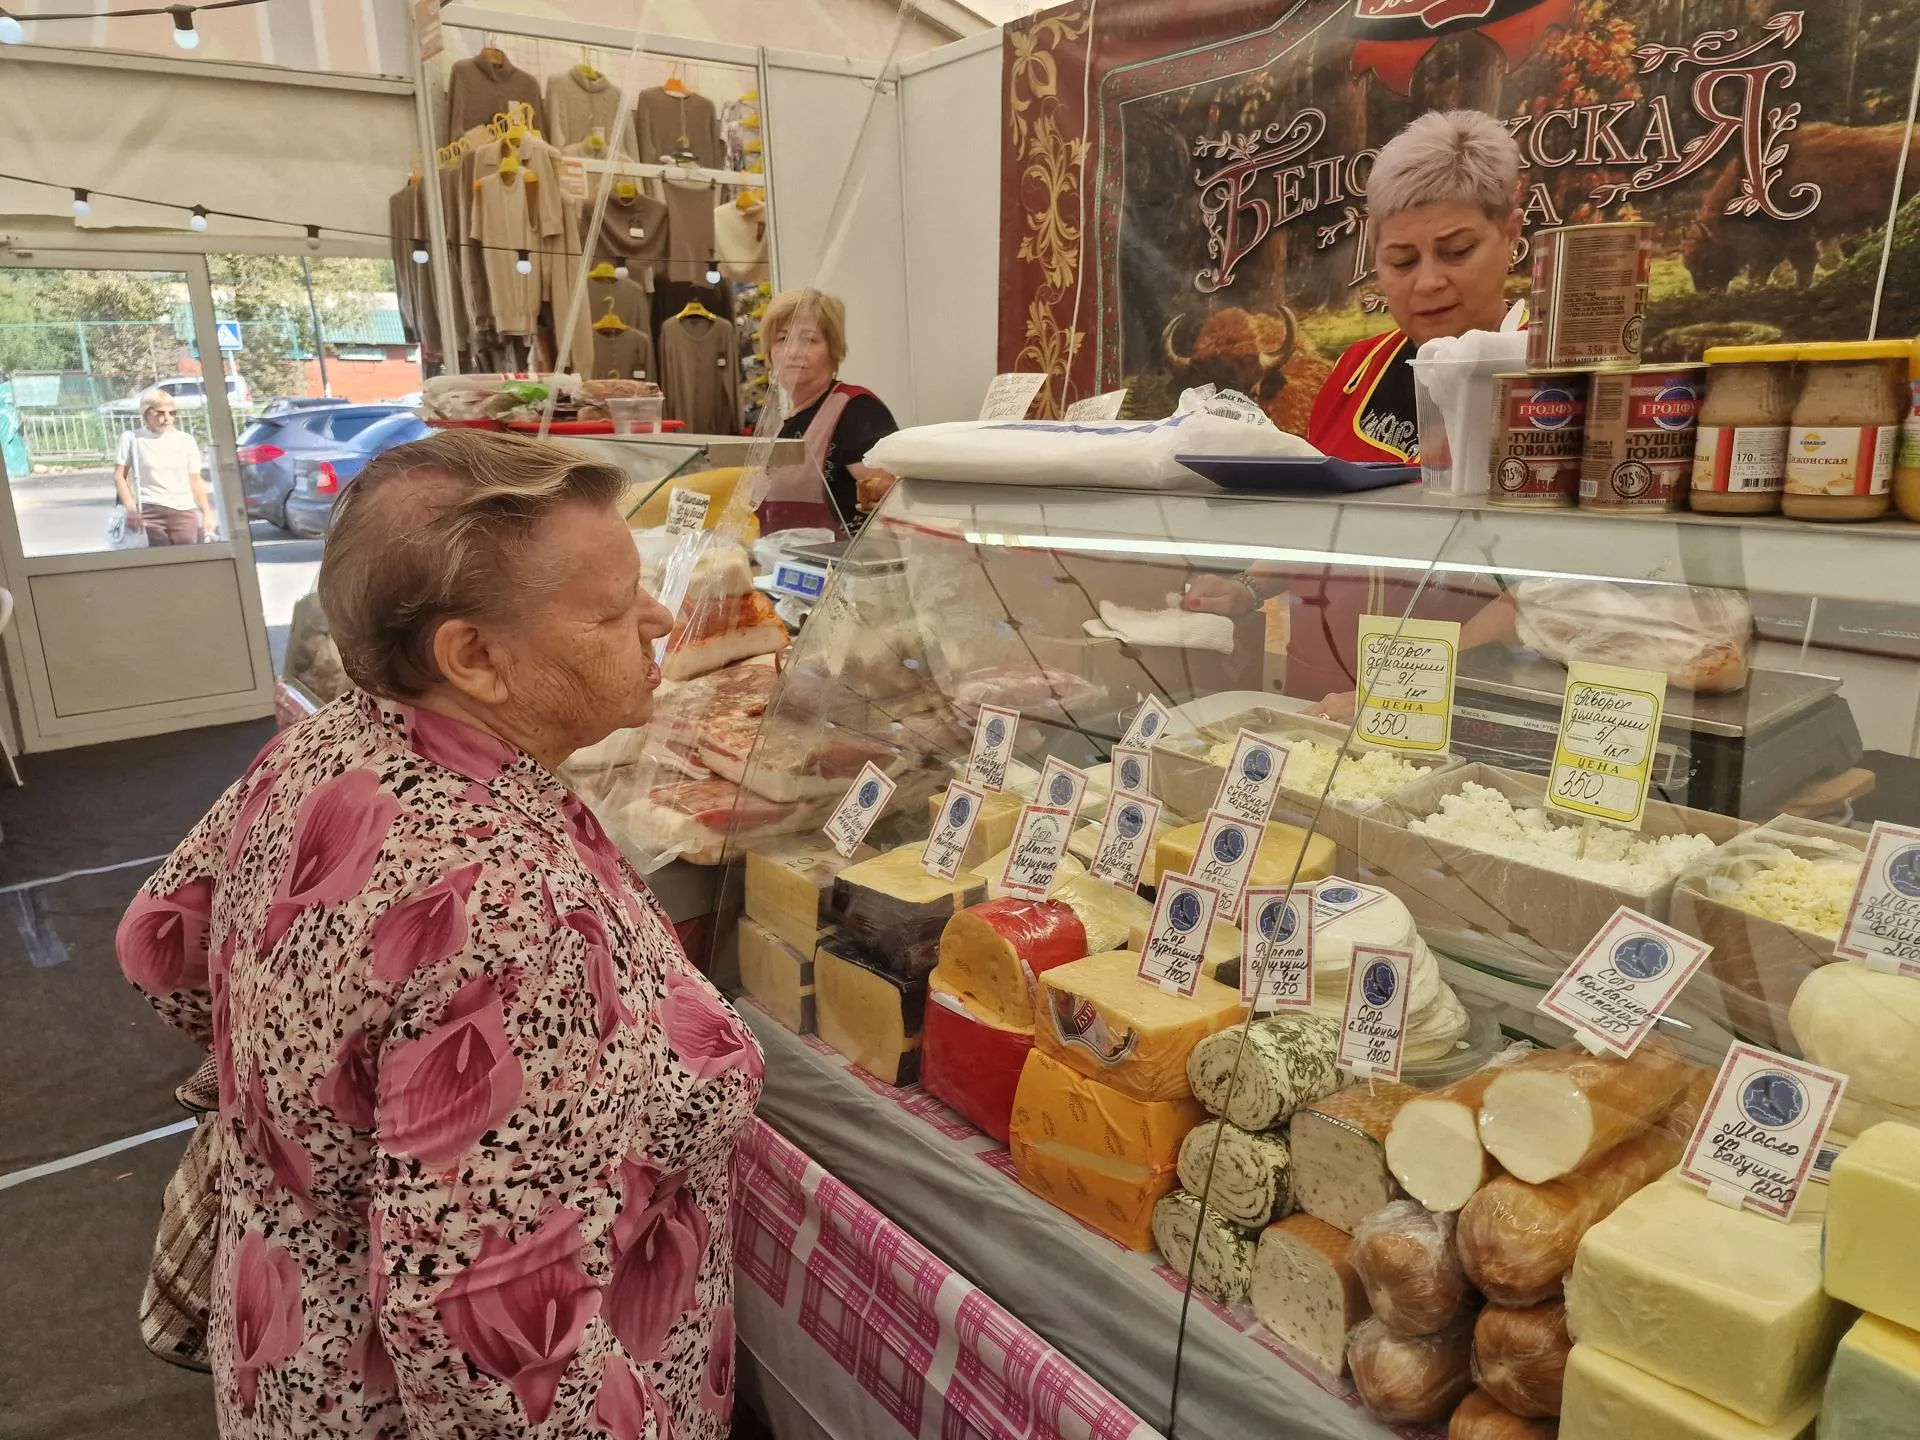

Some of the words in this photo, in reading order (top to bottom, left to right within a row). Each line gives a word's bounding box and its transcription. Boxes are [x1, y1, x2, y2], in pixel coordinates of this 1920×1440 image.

[1194, 61, 1822, 293] БЕЛОСКАЯ
[1737, 453, 1753, 462] 170
[1368, 635, 1431, 660] Творог
[1382, 700, 1424, 711] ЦЕНА
[1574, 687, 1632, 711] Творог
[1578, 757, 1618, 774] ЦЕНА
[1236, 777, 1260, 794] Сыр
[1205, 860, 1231, 877] Сыр
[1869, 892, 1920, 916] Мас
[1162, 927, 1186, 947] Сыр
[1272, 981, 1298, 995] 950
[1597, 968, 1635, 991] Сыр
[1358, 1005, 1382, 1025] Сыр
[1712, 1134, 1740, 1151] от
[1723, 1121, 1799, 1155] Масло
[1713, 1145, 1797, 1186] бабушки
[1750, 1180, 1796, 1203] 1200
